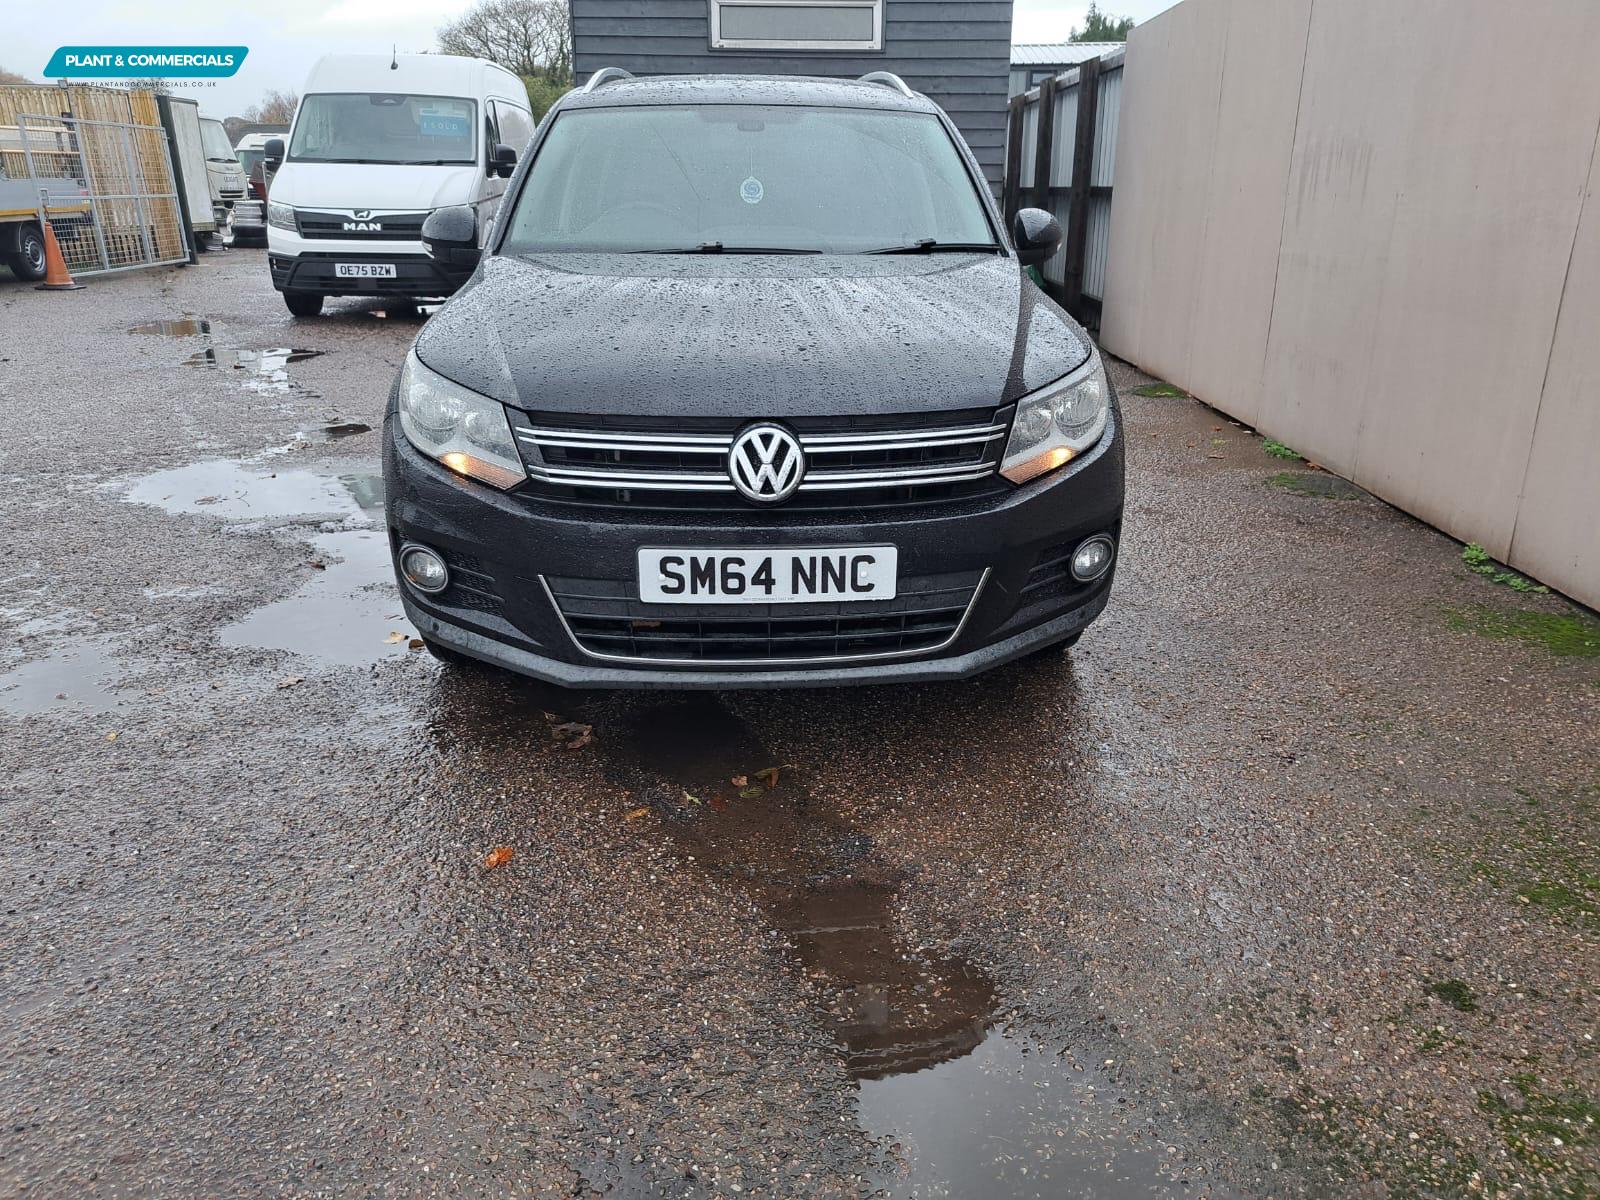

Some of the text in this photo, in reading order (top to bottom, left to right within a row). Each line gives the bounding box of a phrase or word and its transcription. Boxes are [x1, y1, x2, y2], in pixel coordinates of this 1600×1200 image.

[343, 222, 382, 231] MAN
[731, 427, 802, 499] VW
[659, 554, 876, 595] SM64 NNC
